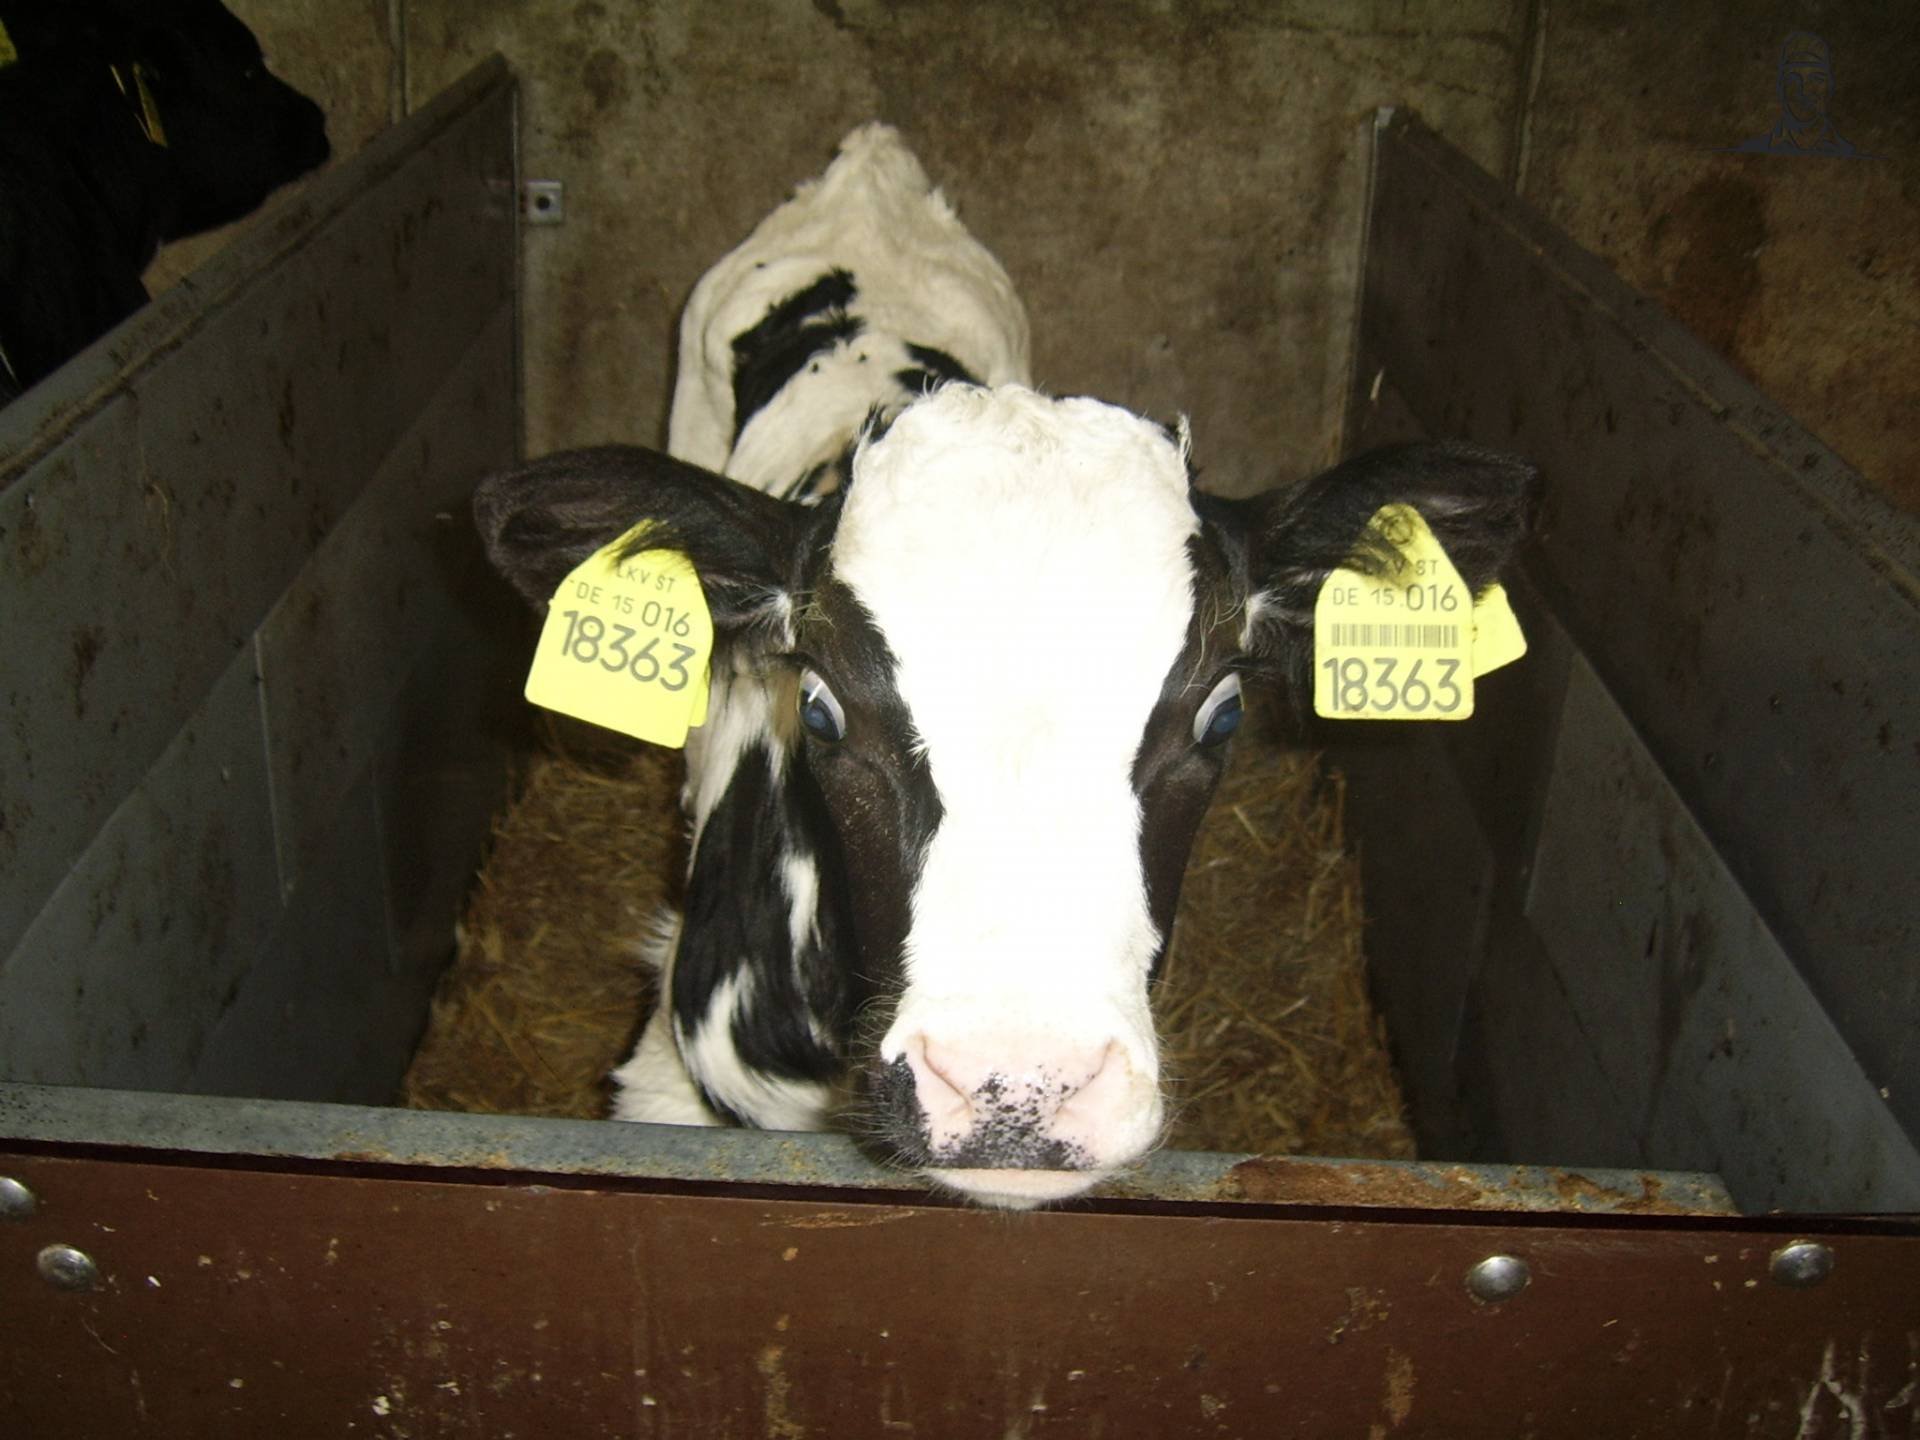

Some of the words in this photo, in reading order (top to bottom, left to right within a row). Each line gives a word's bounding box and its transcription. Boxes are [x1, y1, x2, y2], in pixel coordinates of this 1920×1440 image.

[575, 581, 604, 605] DE
[611, 594, 636, 615] 15
[641, 600, 691, 637] 016
[655, 573, 676, 593] ST
[1332, 587, 1359, 606] DE
[561, 610, 697, 692] 18363
[1322, 656, 1463, 713] 18363
